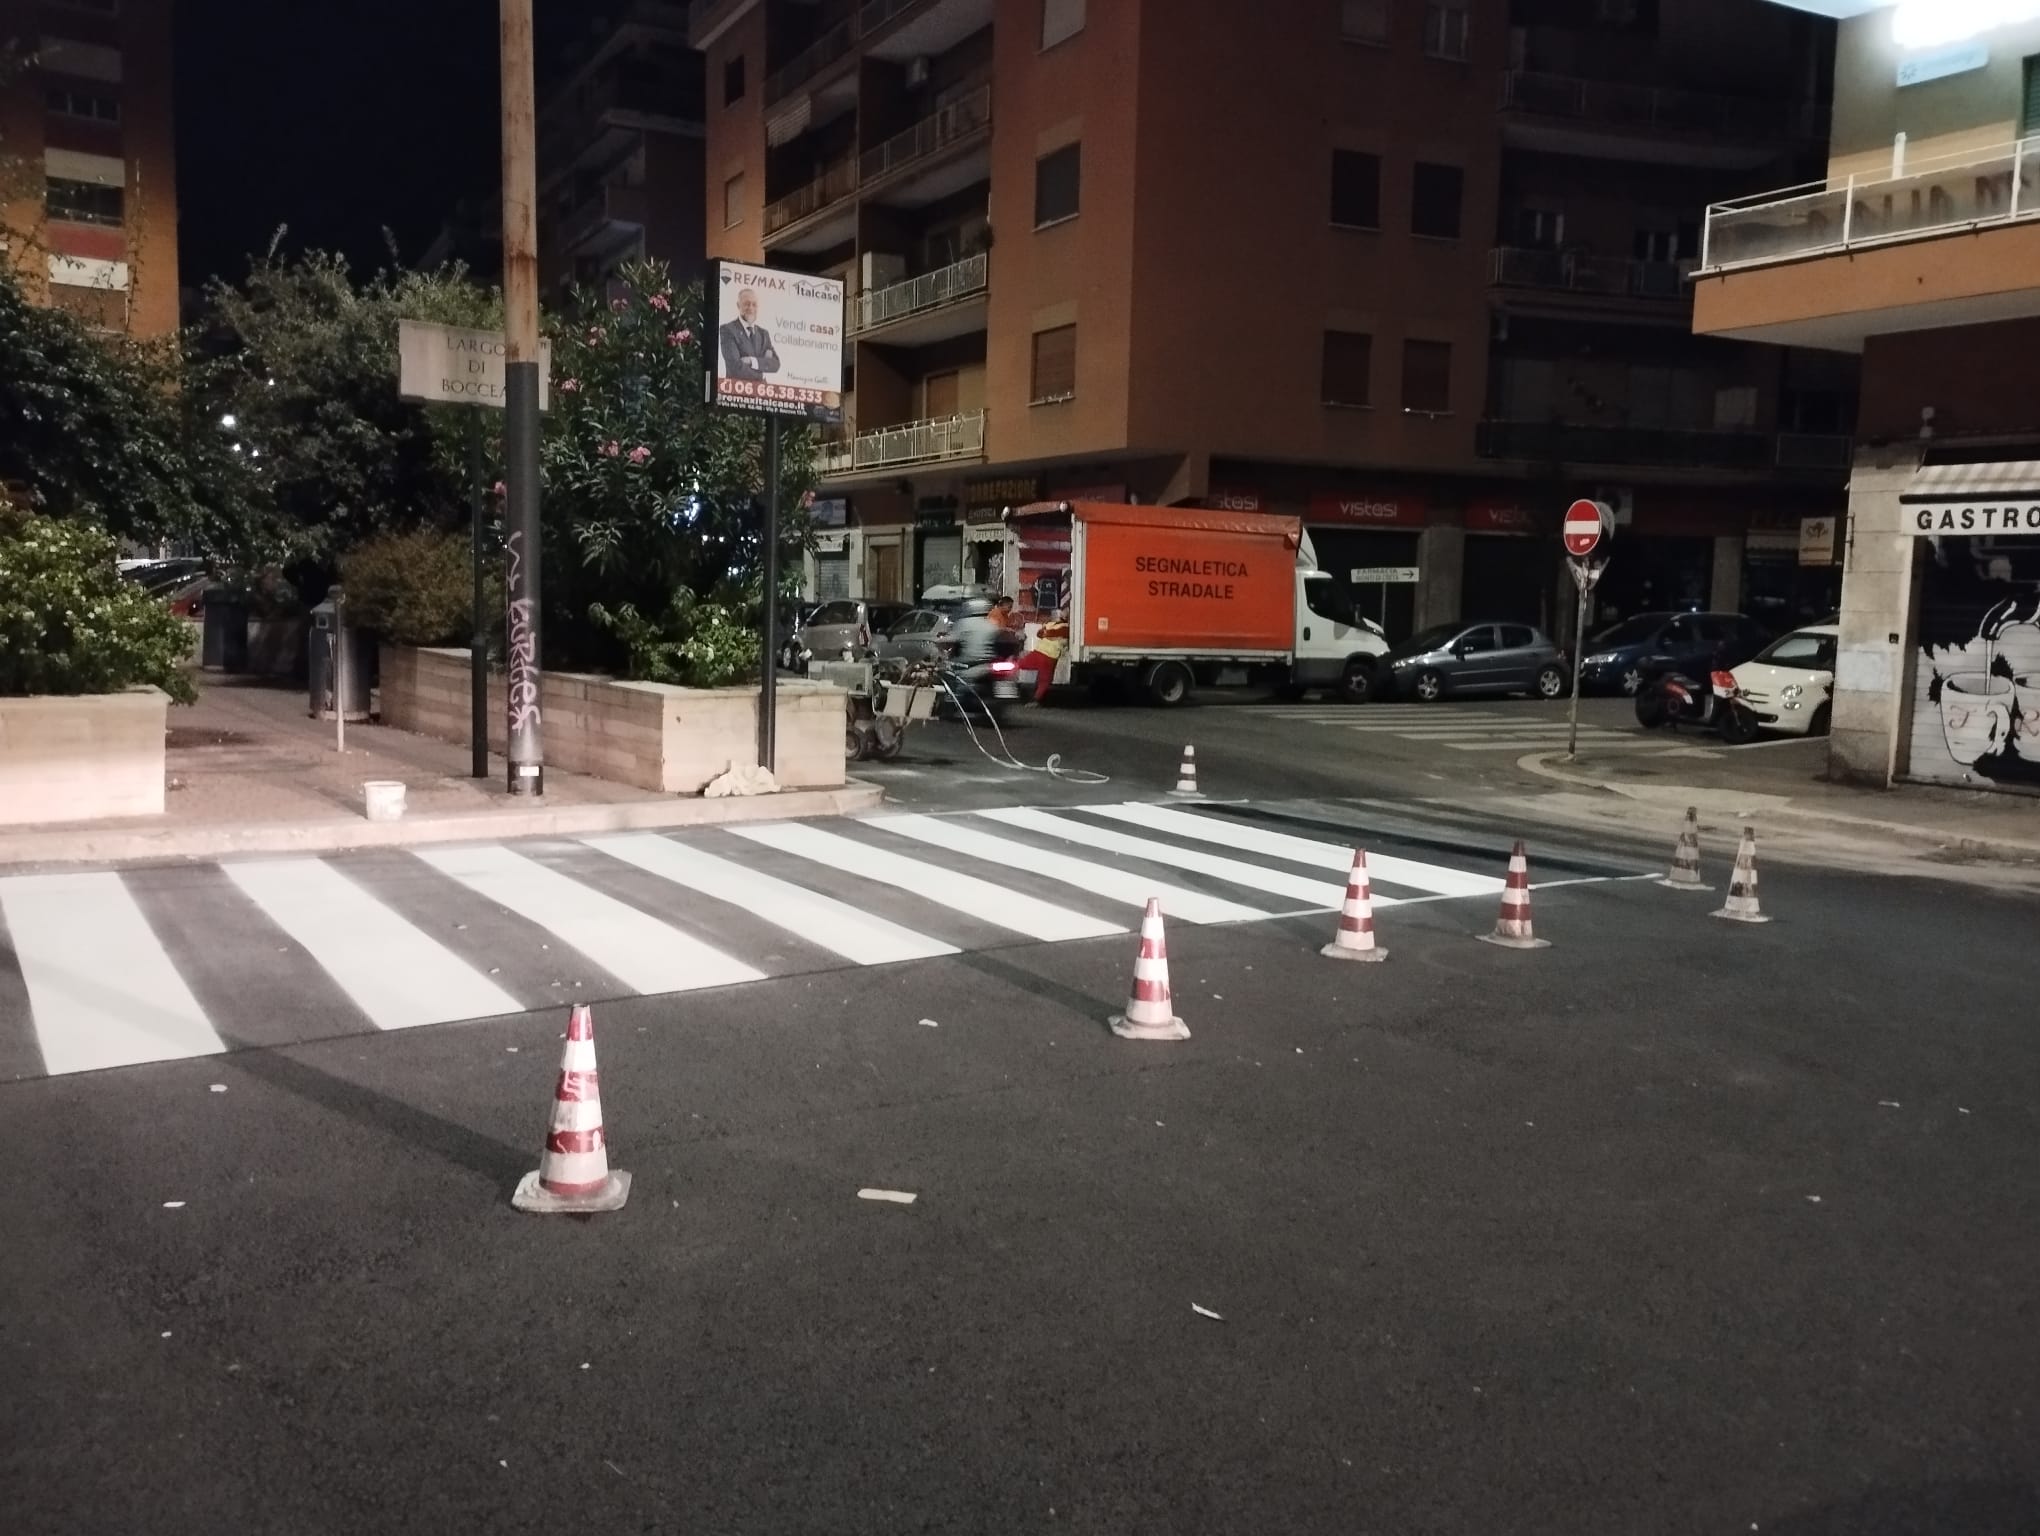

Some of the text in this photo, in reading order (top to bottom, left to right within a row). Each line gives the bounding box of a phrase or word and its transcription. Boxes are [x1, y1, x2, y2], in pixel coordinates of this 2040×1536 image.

[734, 271, 786, 290] RE/MAX
[775, 315, 840, 337] Vendi casa?
[447, 336, 506, 357] LARGO
[773, 333, 840, 352] Collaboriamo.
[468, 359, 486, 375] DI
[735, 381, 823, 403] 06 66.38.333
[1134, 555, 1249, 578] SEGNALETICA
[1147, 579, 1236, 601] STRADALE
